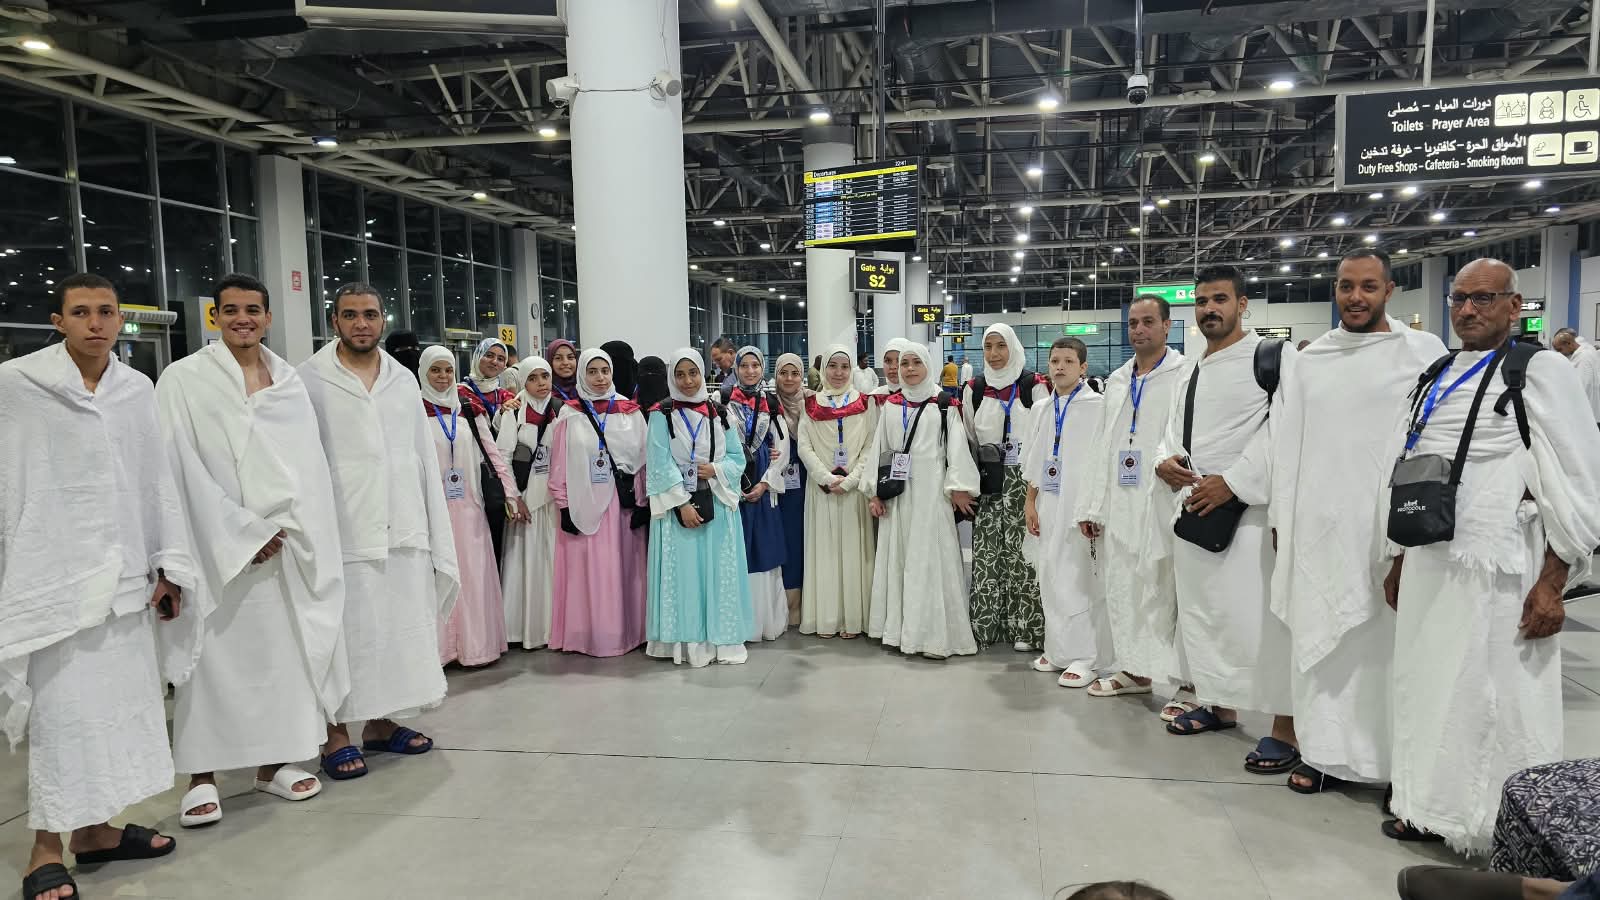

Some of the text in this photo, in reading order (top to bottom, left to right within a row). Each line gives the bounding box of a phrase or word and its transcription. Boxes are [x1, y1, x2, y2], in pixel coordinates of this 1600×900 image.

[1434, 98, 1459, 112] المياه
[1462, 97, 1492, 111] دورات
[1391, 116, 1490, 133] Toilets Prayer Area
[1424, 139, 1457, 157] كافتيريا
[1466, 137, 1489, 153] الحرة
[1491, 133, 1527, 152] الأسواق
[1360, 146, 1389, 160] تدخين
[1390, 143, 1413, 158] غرفة
[1358, 163, 1377, 177] Duty
[1377, 162, 1394, 174] Free
[1395, 161, 1418, 174] Shops
[1425, 157, 1460, 171] Cafeteria
[1466, 155, 1500, 170] Smoking
[1500, 154, 1524, 166] Room
[860, 263, 876, 272] Gate
[880, 263, 895, 275] بوابة
[869, 274, 886, 288] S2
[923, 313, 936, 322] S3
